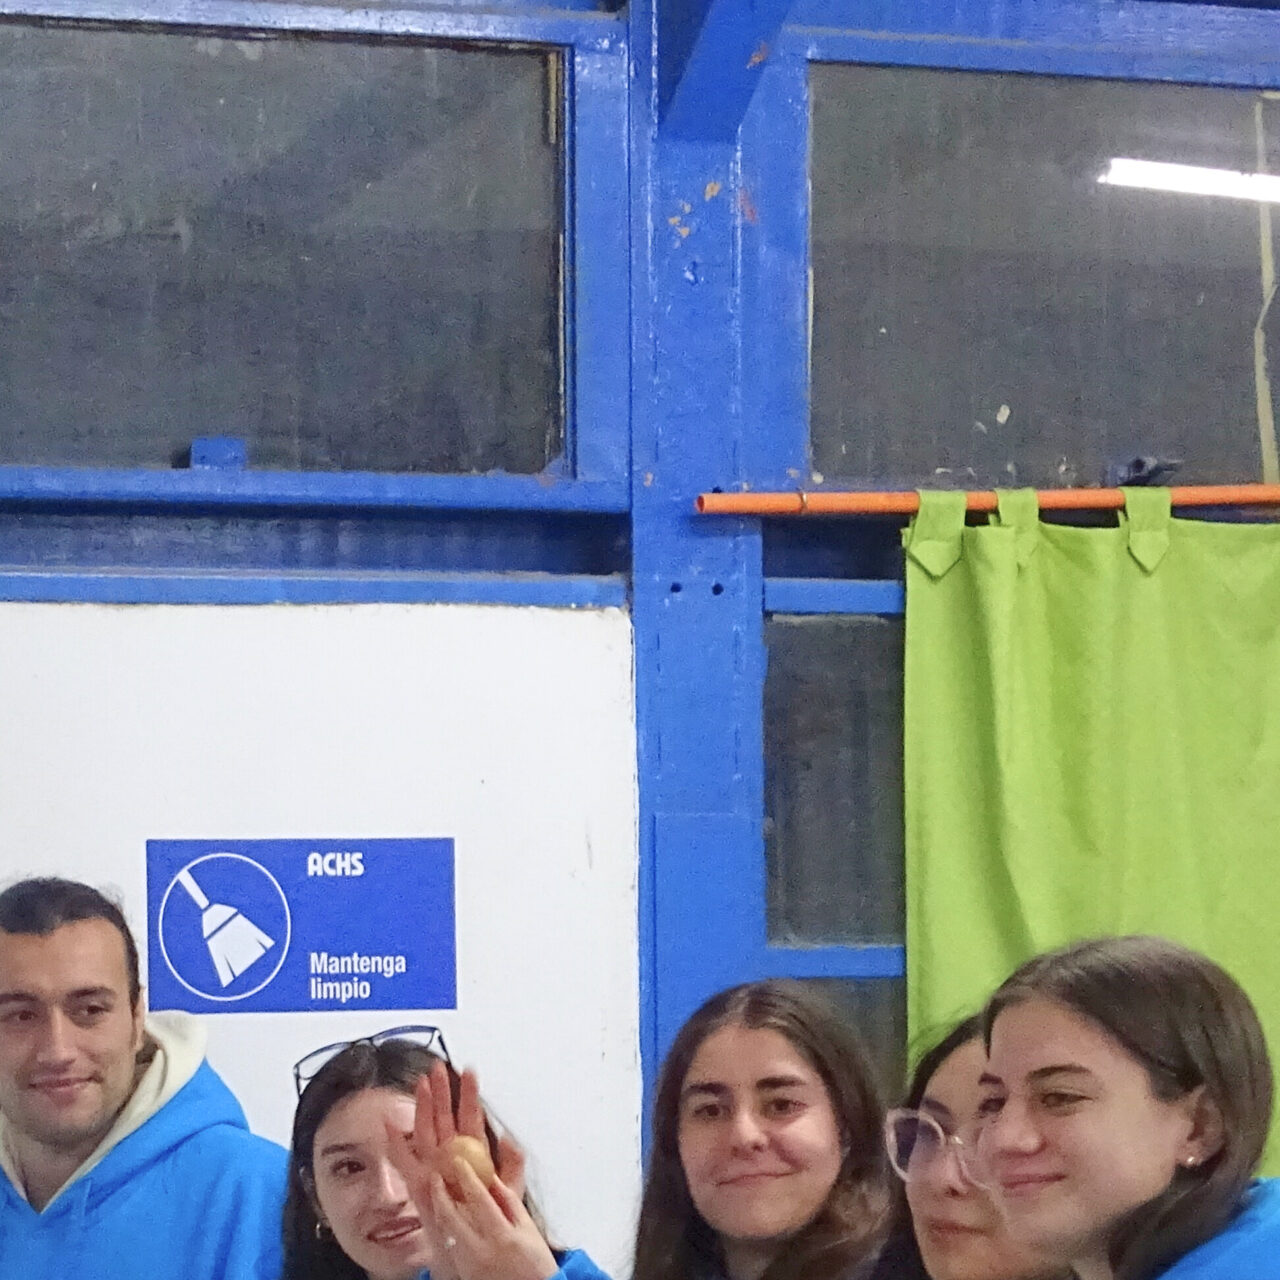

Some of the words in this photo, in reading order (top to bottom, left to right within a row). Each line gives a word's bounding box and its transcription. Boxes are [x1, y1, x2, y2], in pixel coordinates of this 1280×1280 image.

[307, 852, 365, 877] ACHS
[309, 951, 407, 978] Mantenga
[310, 977, 371, 1003] limpio
